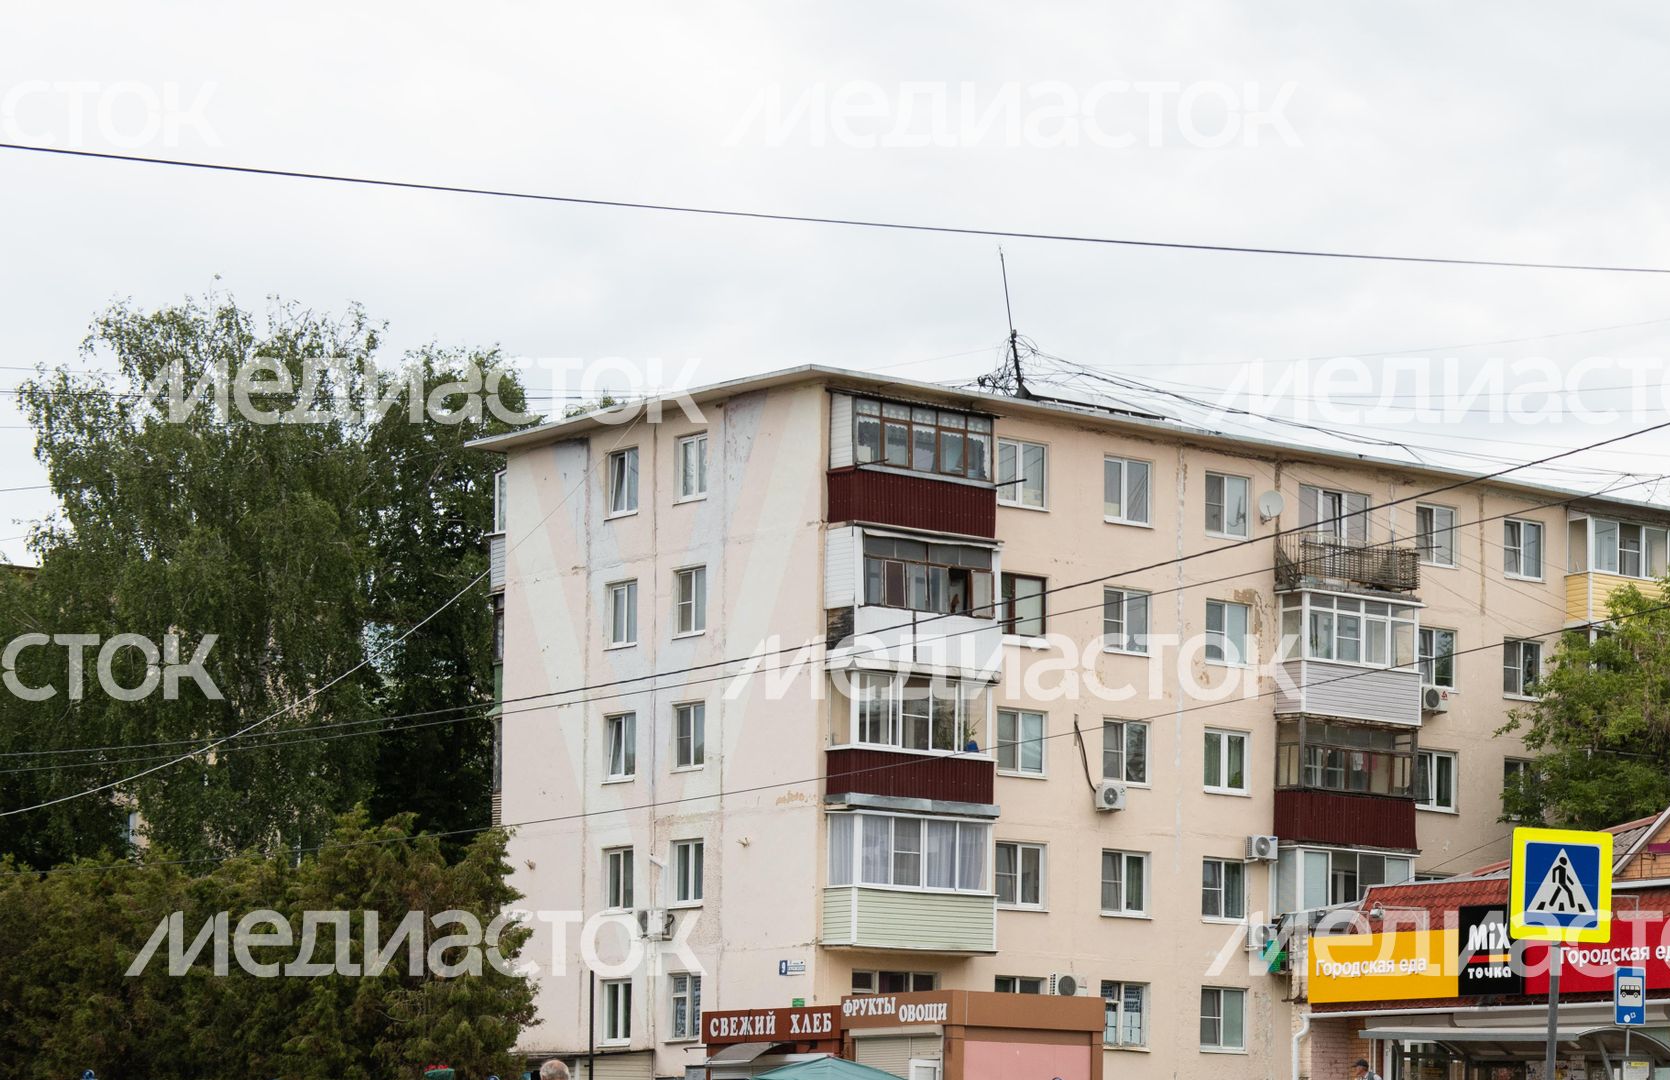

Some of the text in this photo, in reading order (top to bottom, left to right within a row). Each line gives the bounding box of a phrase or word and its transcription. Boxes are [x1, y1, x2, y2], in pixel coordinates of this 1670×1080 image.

[1560, 939, 1650, 965] Городская
[1315, 957, 1427, 978] Городская еда
[1467, 966, 1512, 979] точка
[842, 996, 948, 1023] ФРУКТЫ ОВОЩИ
[709, 1011, 832, 1037] СВЕЖИЙ ХЛЕБ
